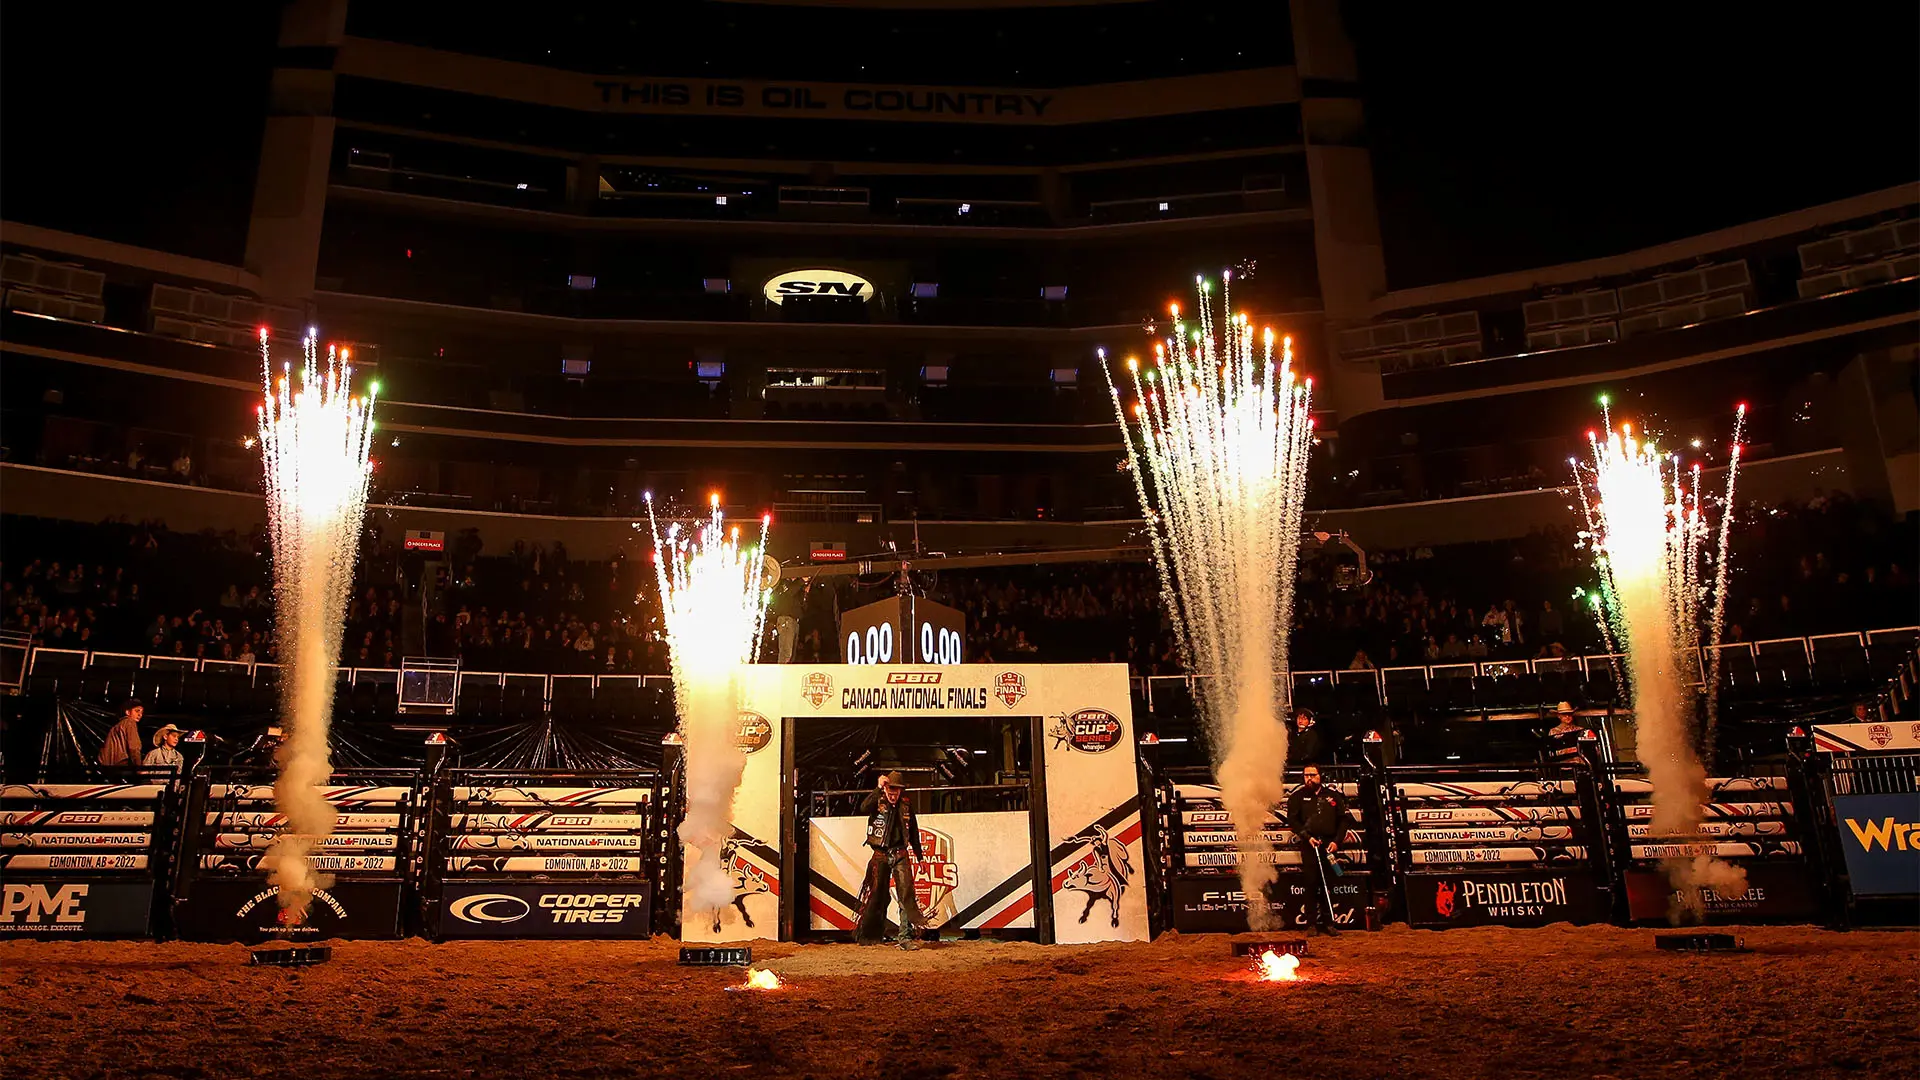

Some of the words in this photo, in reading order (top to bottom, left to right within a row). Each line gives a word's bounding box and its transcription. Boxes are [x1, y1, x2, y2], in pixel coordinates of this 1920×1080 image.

[594, 82, 690, 105] THIS
[706, 85, 744, 106] IS
[762, 87, 826, 109] OIL
[844, 90, 1053, 116] COUNTRY
[776, 281, 866, 296] SN
[847, 622, 893, 665] 0.00
[921, 622, 961, 665] 0.00
[888, 672, 942, 684] PBR
[802, 686, 834, 695] FINALS
[994, 686, 1027, 695] FINALS
[842, 688, 888, 709] CANADA
[890, 688, 945, 709] NATIONAL
[947, 687, 987, 708] FINALS
[1076, 713, 1107, 721] PBR
[1075, 725, 1107, 735] CUP
[1082, 744, 1106, 752] Wrangler
[59, 814, 102, 824] PBR
[551, 817, 592, 825] PBR
[1190, 812, 1230, 822] PBR
[1415, 812, 1452, 820] PBR
[41, 836, 97, 844] NATIONAL
[104, 836, 145, 844] FINALS
[660, 786, 670, 890] Priefert
[1413, 831, 1463, 839] NATIONAL
[1469, 831, 1506, 839] FINALS
[352, 837, 393, 846] FINALS
[536, 838, 591, 846] NATIONAL
[597, 838, 637, 846] FINALS
[1198, 854, 1239, 865] EDMONTON,
[1424, 851, 1465, 863] EDMONTON,
[1466, 850, 1476, 861] AB
[1483, 850, 1501, 861] 2022
[49, 857, 94, 869] EDMONTON,
[95, 857, 107, 868] AB
[115, 857, 136, 868] 2022
[304, 857, 342, 870] DMONTON,
[344, 857, 355, 869] AB
[364, 857, 384, 869] 2022
[545, 858, 588, 871] EDMONTON,
[590, 858, 601, 870] AB
[608, 858, 629, 870] 2022
[1462, 878, 1568, 908] PENDLETON
[0, 884, 90, 922] PME
[236, 900, 256, 919] THE
[254, 885, 281, 904] BLAC
[312, 887, 348, 919] COMPANY
[538, 894, 642, 908] COOPER
[551, 910, 626, 923] TIRES
[1488, 905, 1544, 917] WHISKY
